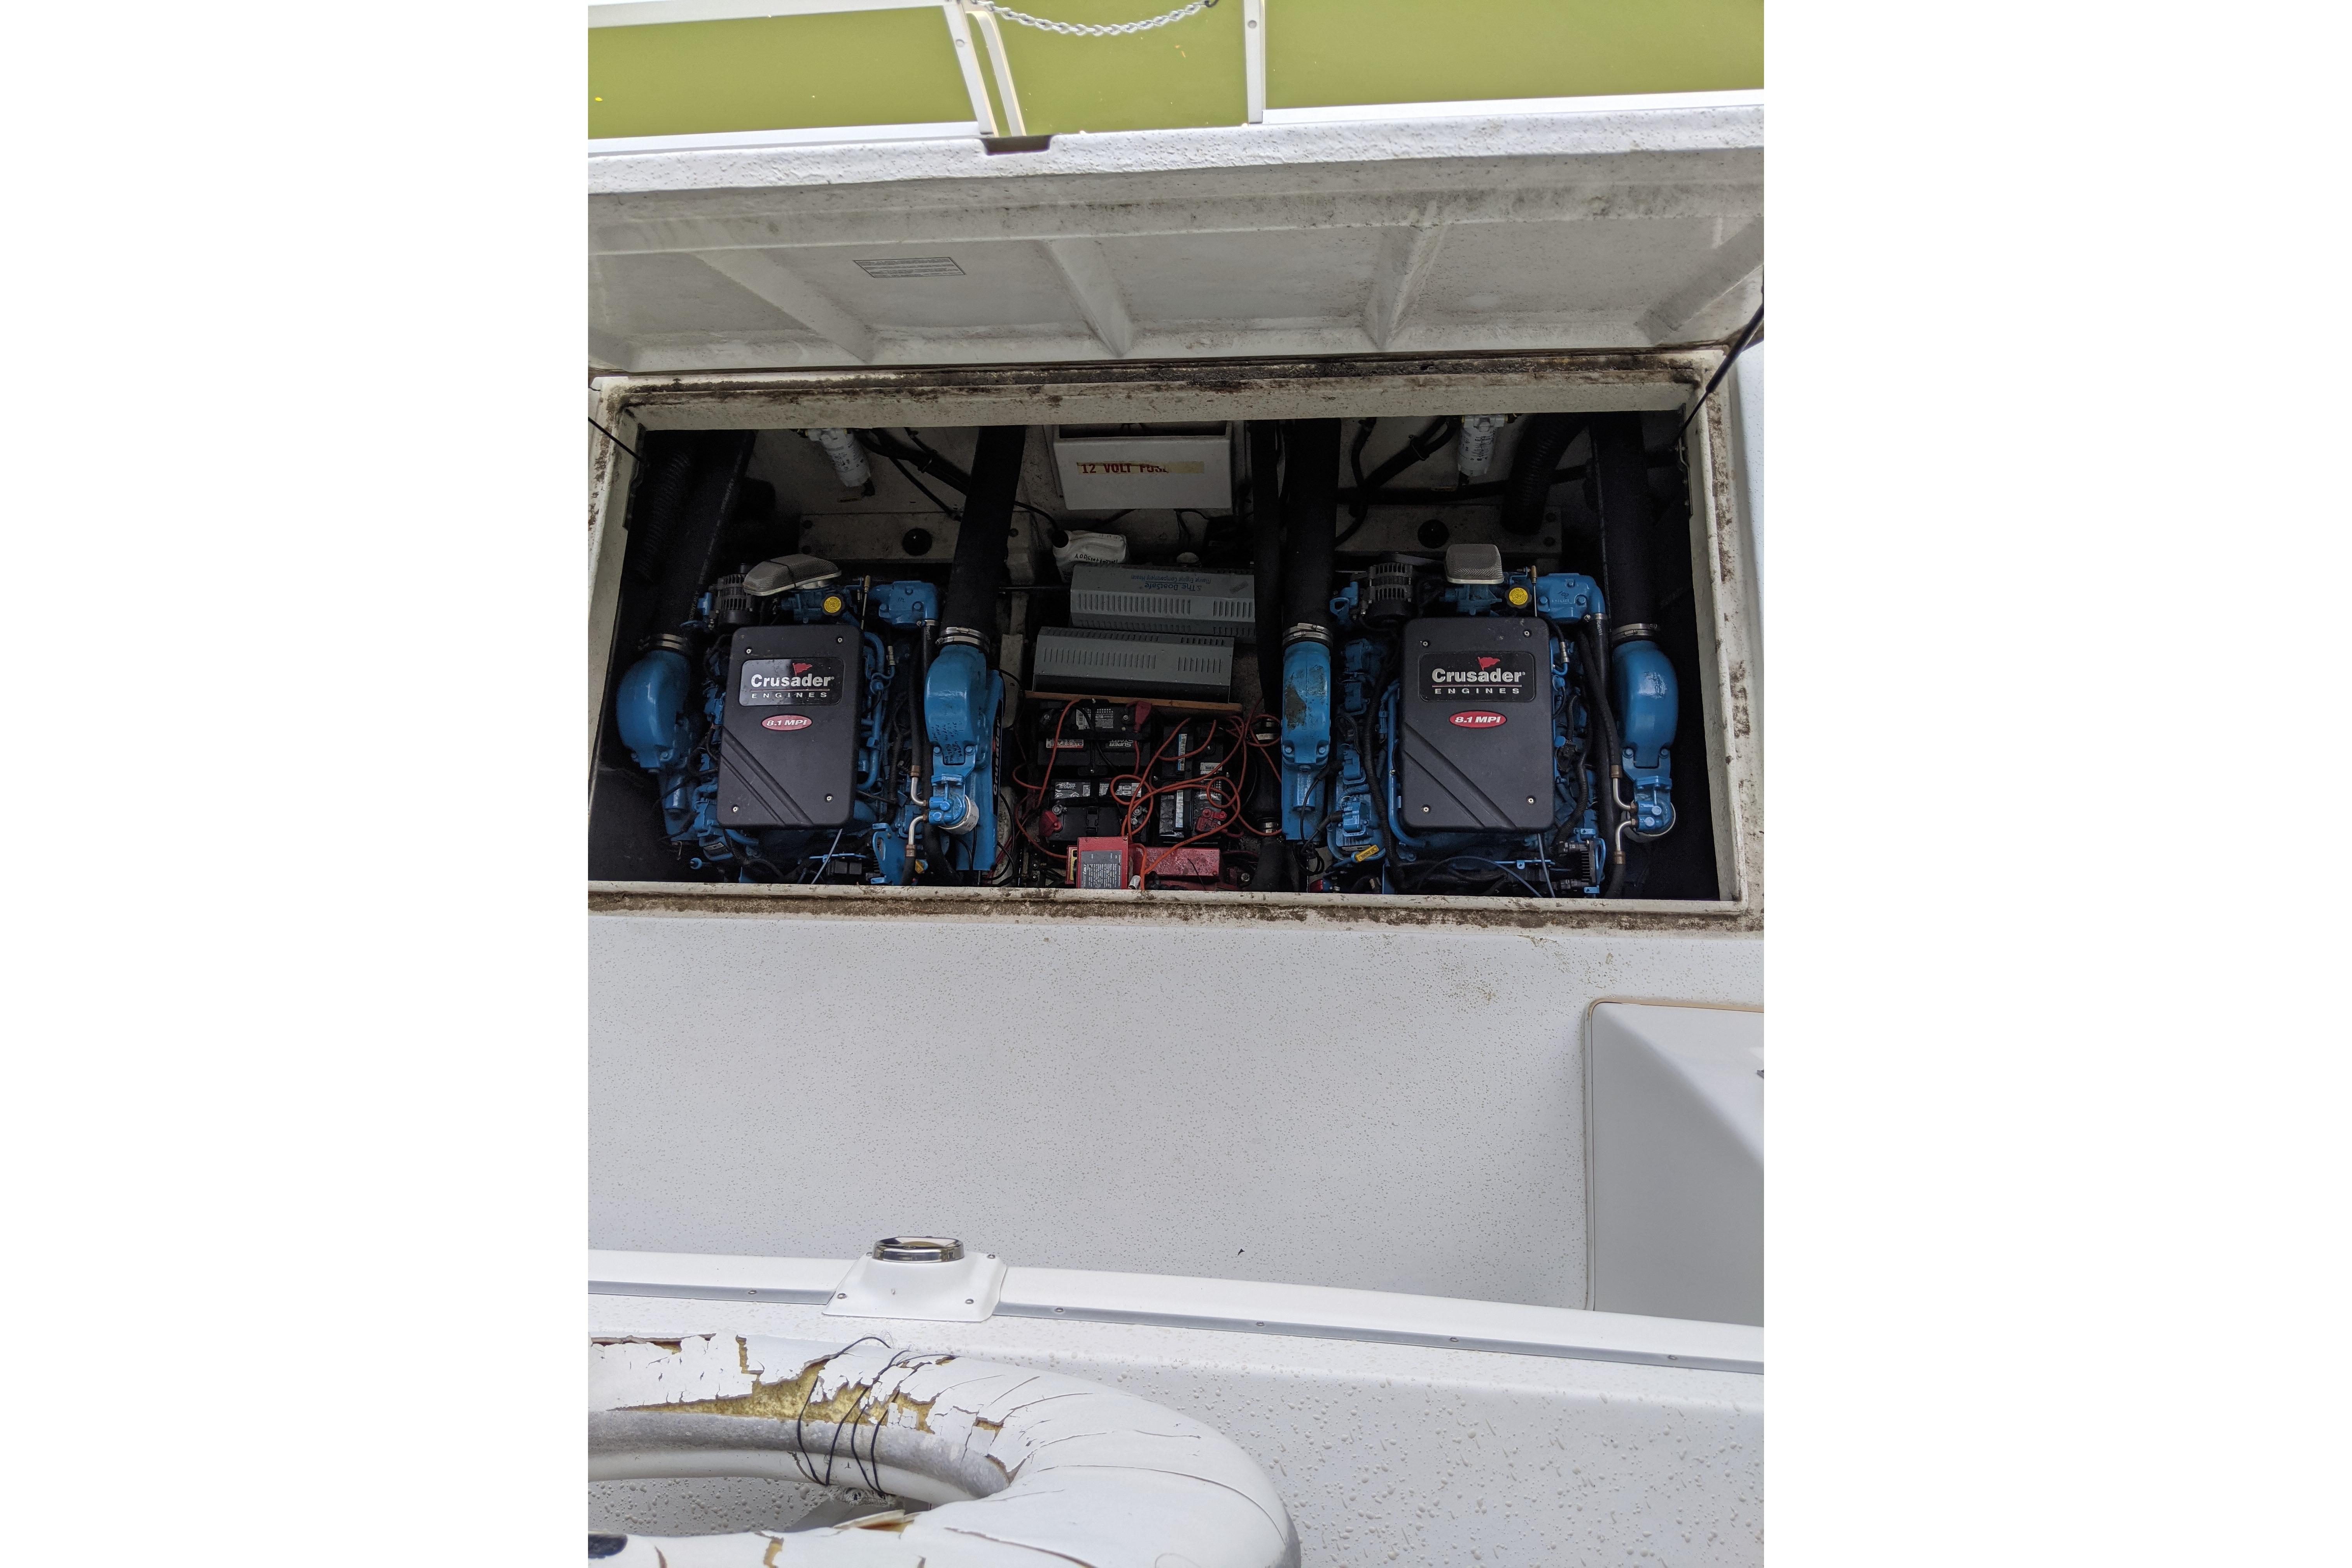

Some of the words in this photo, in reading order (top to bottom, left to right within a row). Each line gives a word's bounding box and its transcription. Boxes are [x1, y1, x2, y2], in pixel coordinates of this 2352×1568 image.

[1081, 464, 1096, 473] 12
[1104, 464, 1131, 473] VOLT
[751, 674, 831, 687] Crusader
[1432, 668, 1522, 682] Crusader
